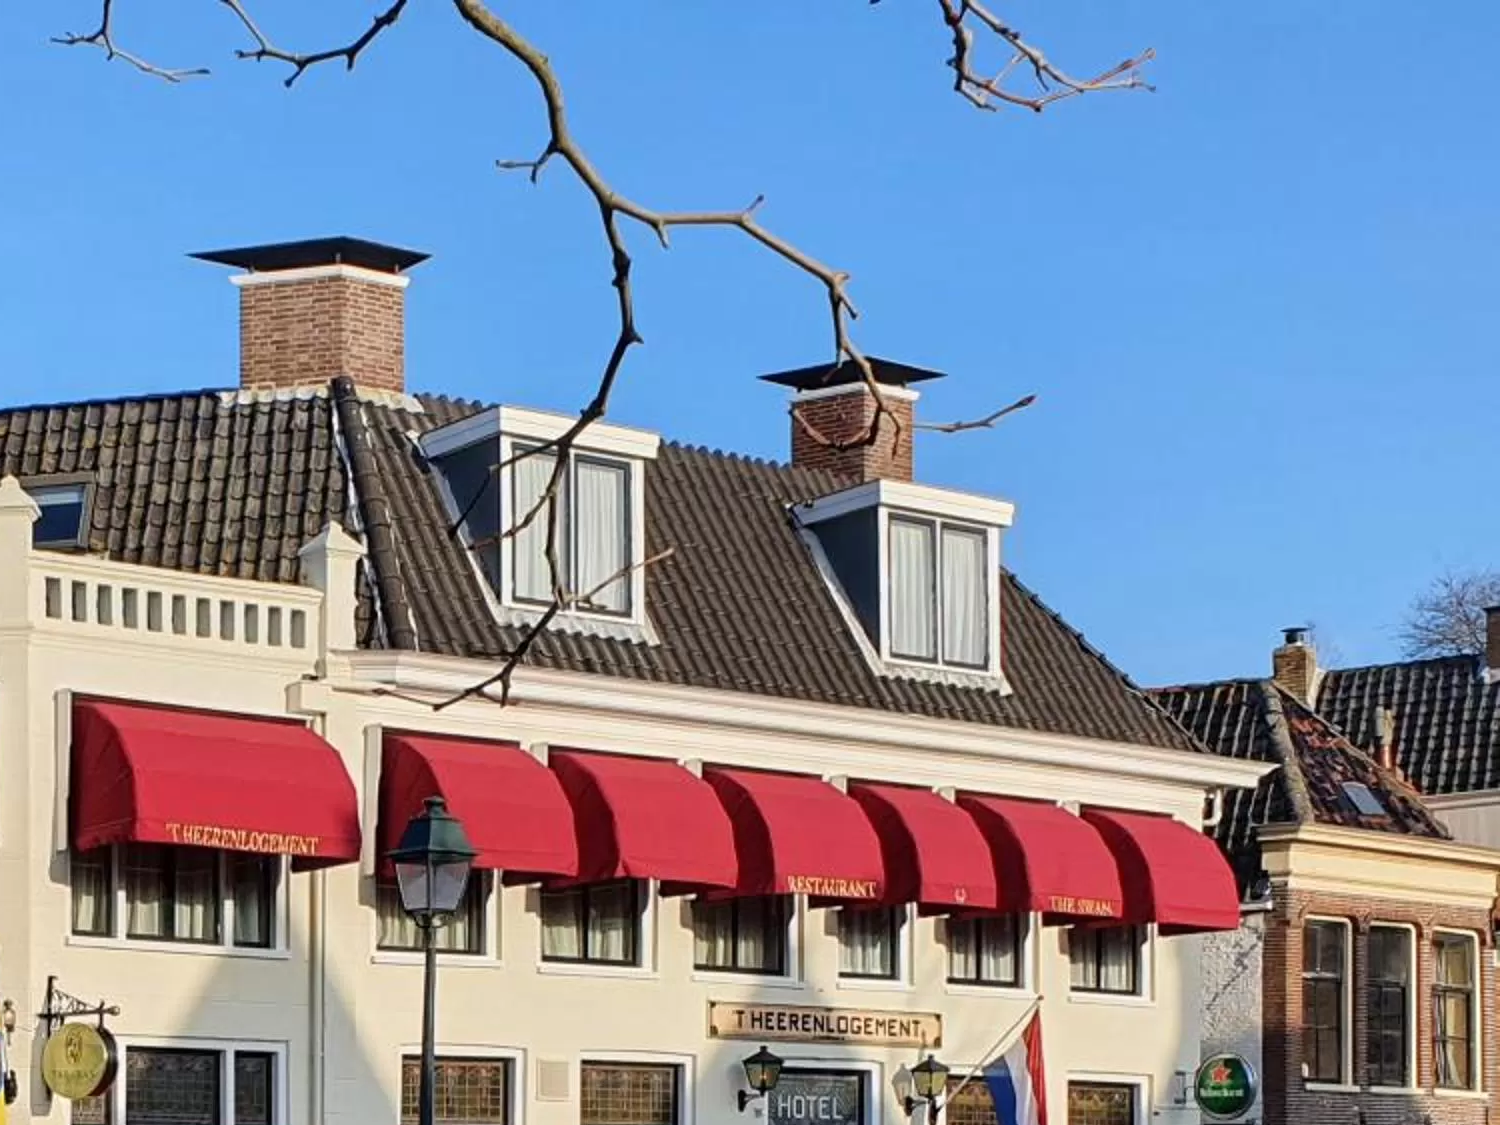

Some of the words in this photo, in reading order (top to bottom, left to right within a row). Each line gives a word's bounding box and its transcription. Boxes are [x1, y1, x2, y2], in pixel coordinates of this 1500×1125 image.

[183, 825, 318, 855] HEERENLOGEMENT
[787, 876, 877, 898] RESTAURANT
[1049, 895, 1076, 912] THE
[1077, 899, 1113, 917] SWAN
[750, 1011, 921, 1039] HEERENLOGEMENT
[778, 1096, 843, 1120] HOTEL
